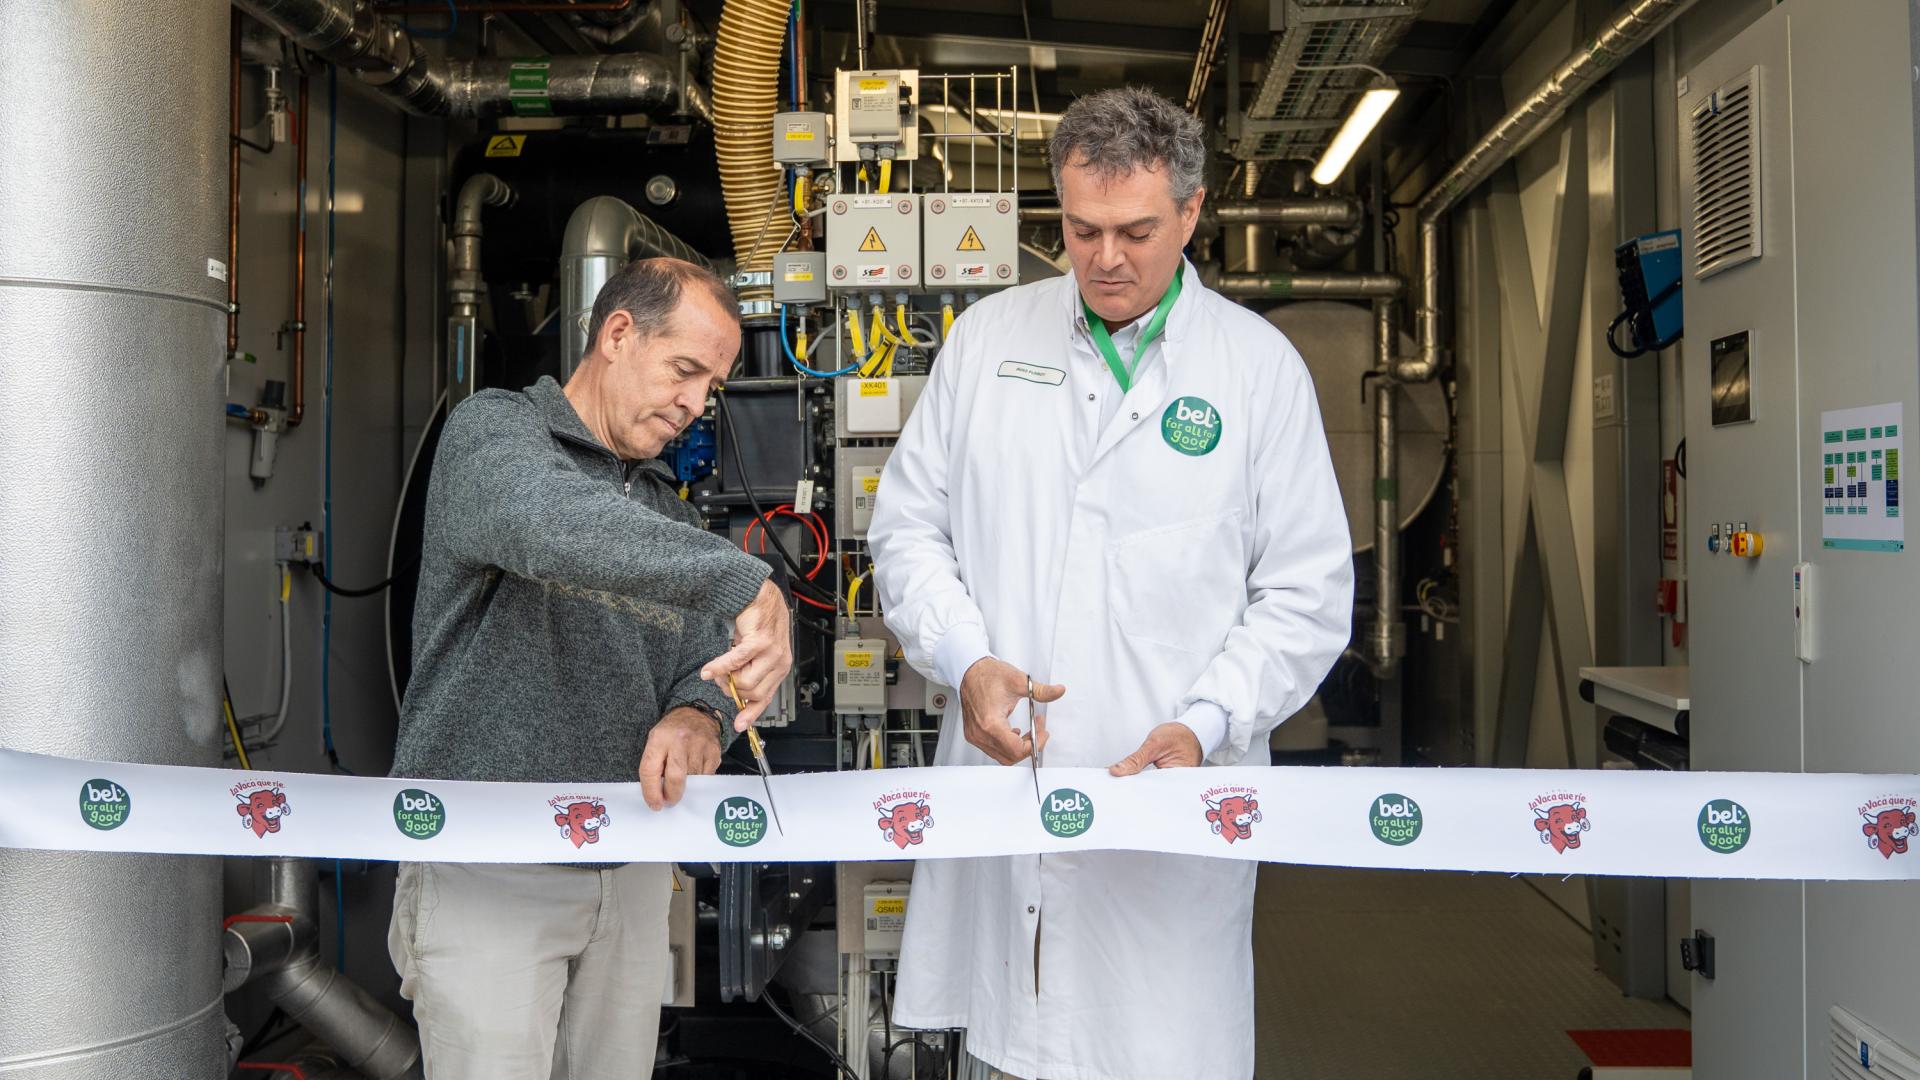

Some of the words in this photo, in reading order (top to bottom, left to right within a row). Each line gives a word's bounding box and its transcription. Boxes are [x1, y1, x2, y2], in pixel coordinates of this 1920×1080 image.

[1176, 399, 1214, 428] bel
[1165, 417, 1183, 430] for
[1203, 429, 1216, 440] for
[1170, 430, 1210, 449] good
[235, 781, 256, 790] Vaca
[257, 780, 271, 788] que
[1207, 787, 1229, 796] Vaca
[1230, 786, 1245, 794] que
[87, 783, 122, 802] bel
[880, 793, 902, 804] Vaca
[902, 791, 918, 799] que
[1535, 794, 1557, 804] Vaca
[1558, 793, 1574, 801] que
[83, 800, 98, 811] for
[401, 793, 437, 811] bel
[1051, 793, 1085, 812] bel
[1379, 798, 1414, 817] bel
[1865, 799, 1888, 810] Vaca
[1889, 797, 1905, 806] que
[397, 810, 412, 820] for
[723, 801, 759, 820] bel
[1045, 811, 1060, 821] for
[1078, 812, 1090, 820] for
[1707, 804, 1742, 824] bel
[90, 811, 121, 823] good
[1374, 816, 1389, 826] for
[405, 820, 437, 832] good
[719, 819, 734, 830] for
[1052, 819, 1085, 832] good
[1702, 823, 1717, 834] for
[725, 829, 758, 841] good
[1381, 826, 1414, 838] good
[1709, 833, 1742, 846] good
